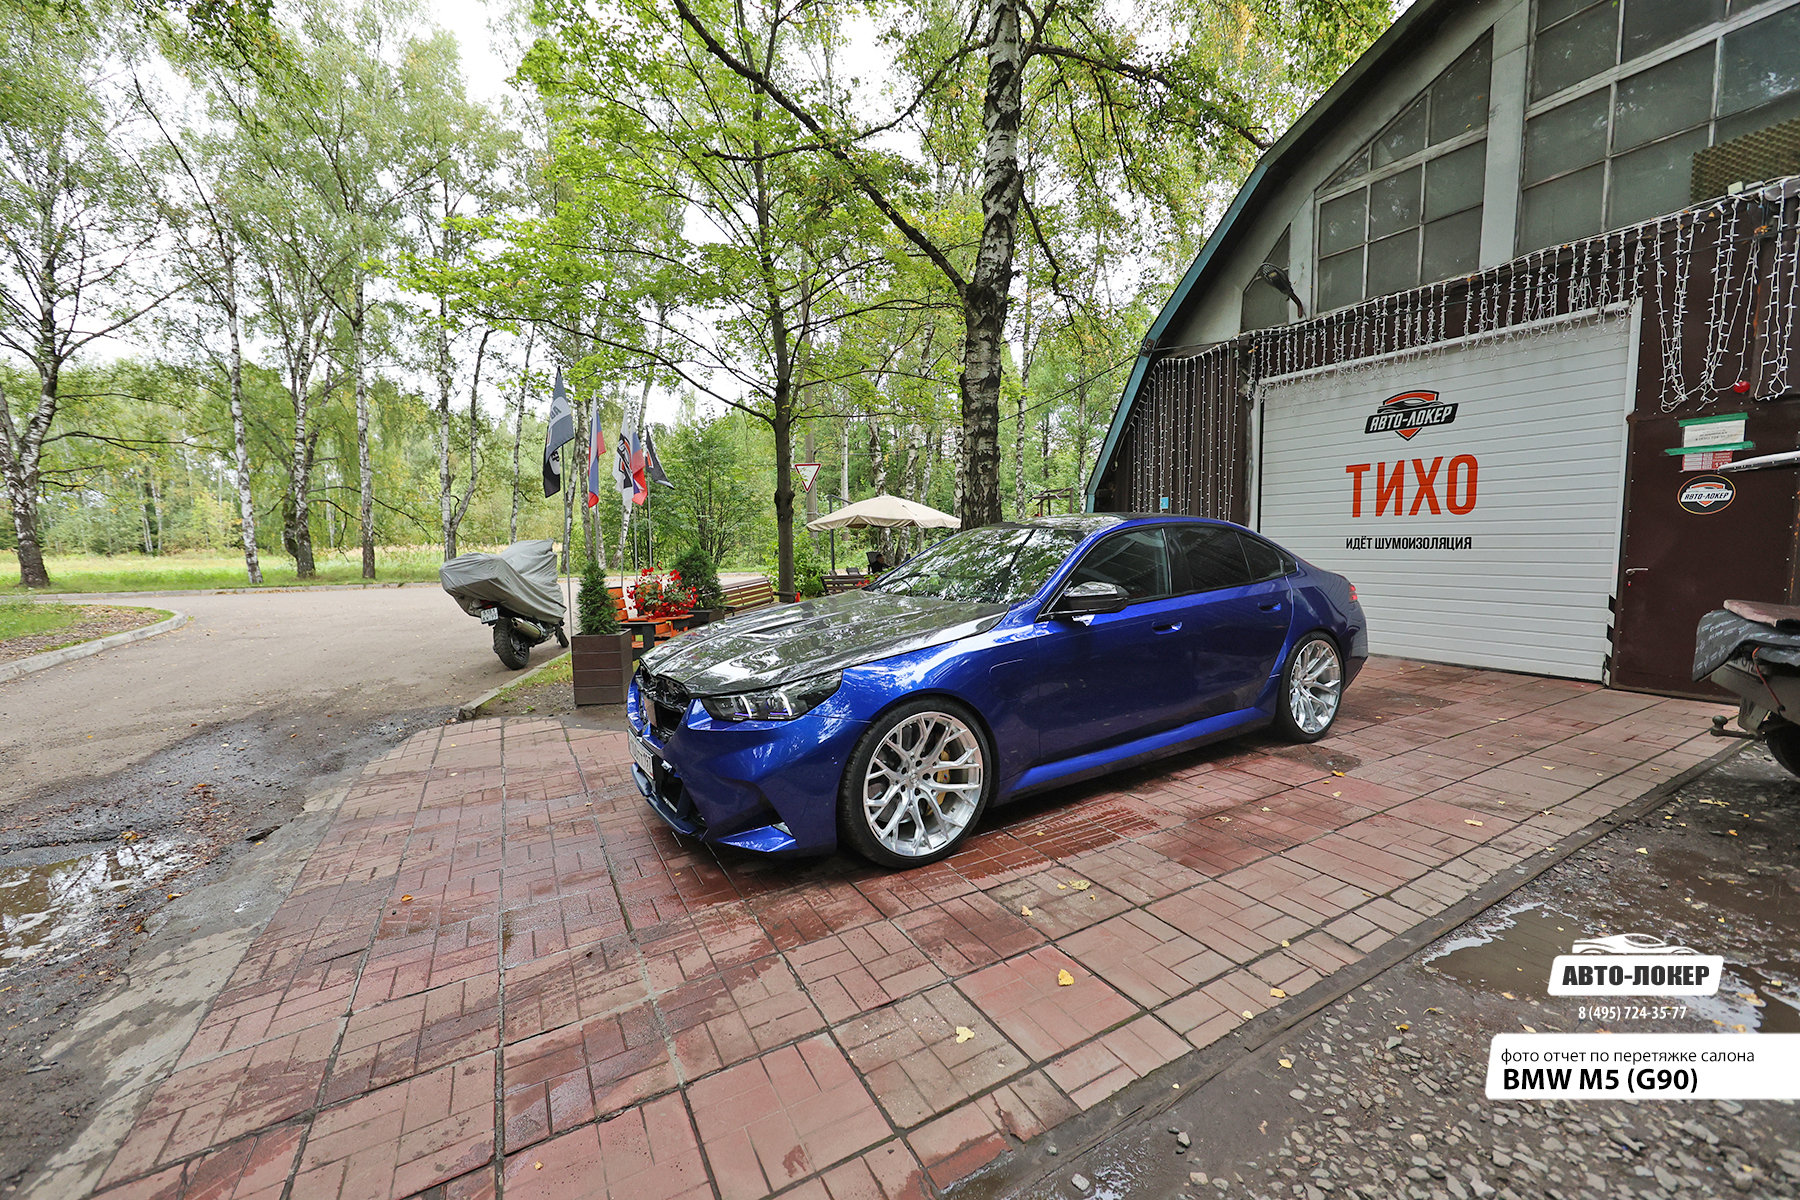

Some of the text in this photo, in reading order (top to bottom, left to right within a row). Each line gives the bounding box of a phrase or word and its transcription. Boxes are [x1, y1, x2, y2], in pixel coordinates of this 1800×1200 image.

[1369, 406, 1453, 432] АВТО-ЛОКЕР
[1345, 454, 1478, 518] ТИХО
[1684, 492, 1730, 500] АВТО-ЛОКЕР
[1345, 535, 1472, 551] ИДЁТ ШУМОИЗОЛЯЦИЯ
